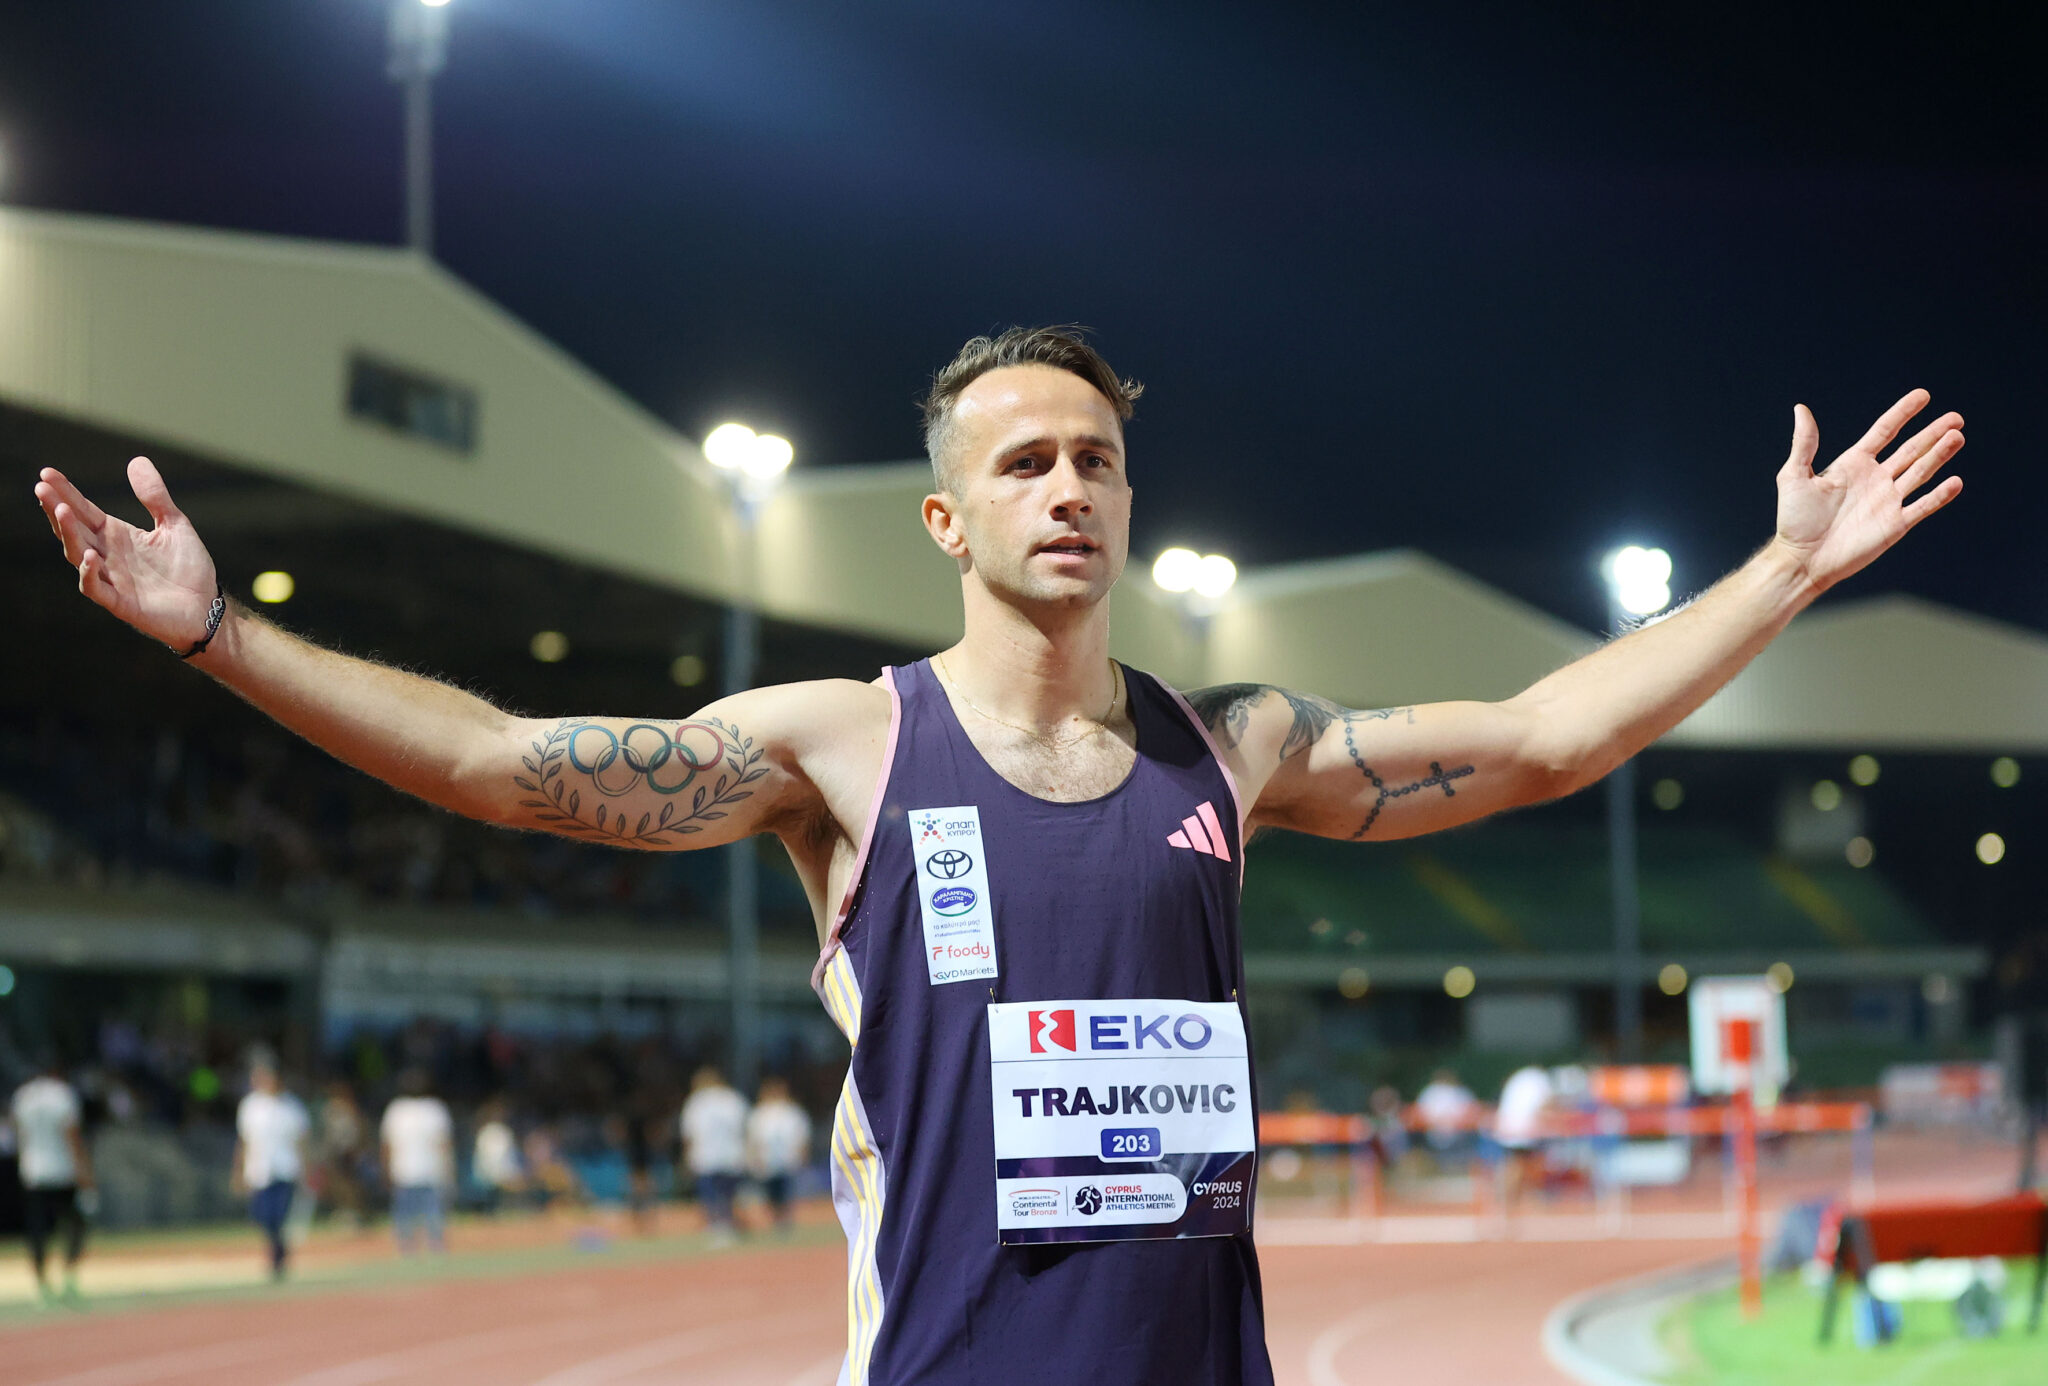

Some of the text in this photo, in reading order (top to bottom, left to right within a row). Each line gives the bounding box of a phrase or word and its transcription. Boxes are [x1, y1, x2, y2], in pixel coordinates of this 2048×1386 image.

[947, 942, 990, 959] foody
[1090, 1013, 1212, 1051] EKO
[1012, 1084, 1236, 1118] TRAJKOVIC
[1112, 1134, 1151, 1153] 203
[1105, 1185, 1142, 1194] CYPRUS
[1193, 1181, 1242, 1195] CYPRUS
[1012, 1200, 1057, 1208] Continental
[1105, 1193, 1175, 1203] INTERNATIONAL
[1212, 1196, 1240, 1209] 2024
[1013, 1209, 1029, 1217] Tour
[1106, 1202, 1176, 1211] ATHLETICS MEETING
